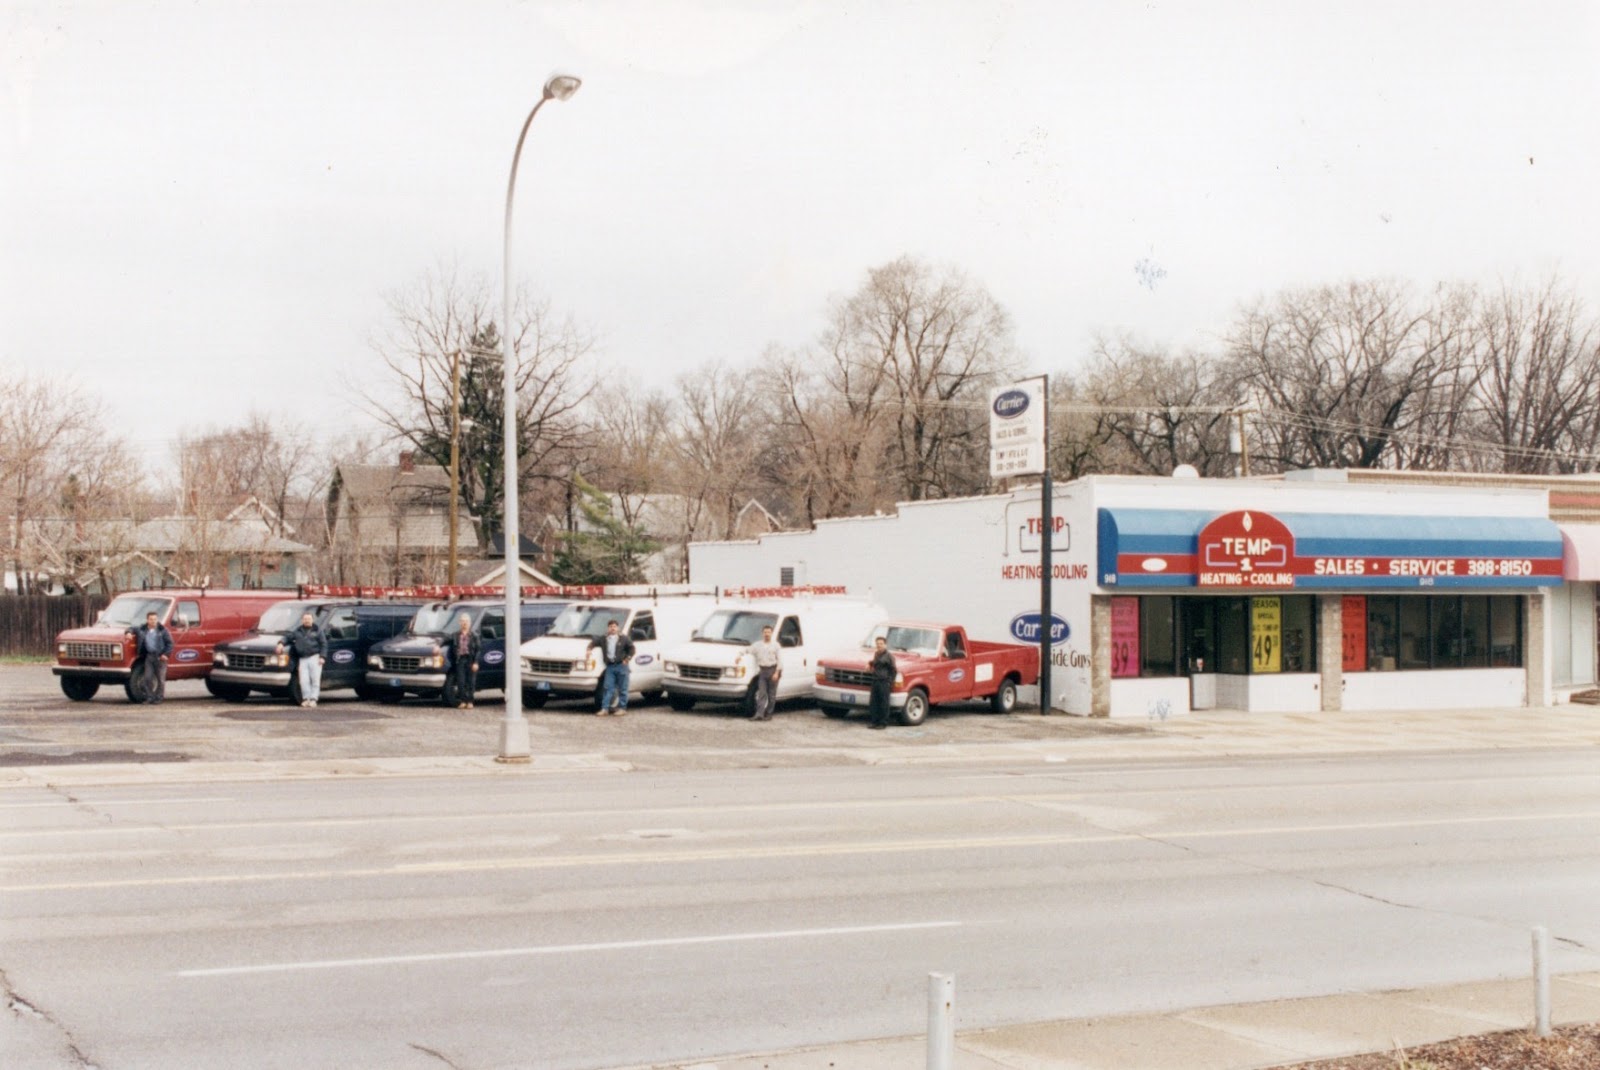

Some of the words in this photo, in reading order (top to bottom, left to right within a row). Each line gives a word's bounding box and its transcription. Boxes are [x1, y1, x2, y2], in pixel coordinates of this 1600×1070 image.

[1222, 537, 1272, 556] TEMP
[1050, 564, 1088, 579] OOLING
[1240, 557, 1253, 571] 1
[1314, 558, 1365, 575] SALES
[1389, 559, 1455, 576] SERVICE
[1200, 573, 1242, 585] HEATING
[1250, 573, 1293, 585] COOLING
[1252, 600, 1279, 608] SEASON
[1015, 618, 1065, 638] Carer
